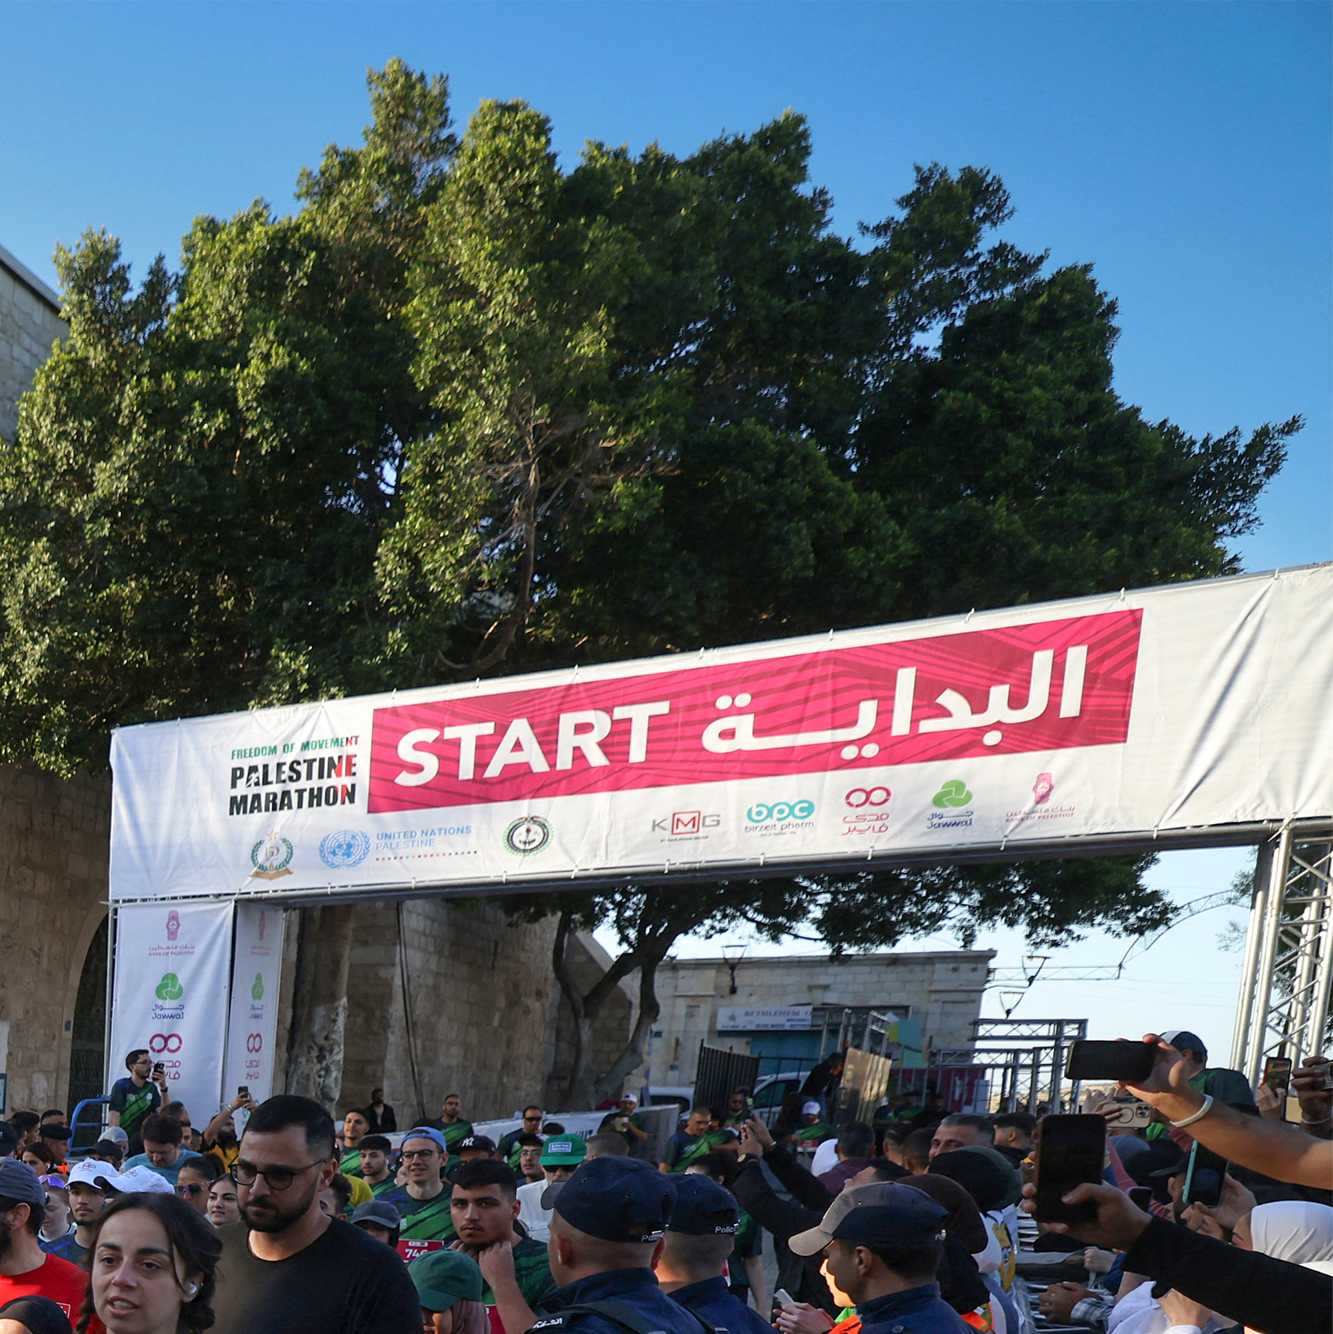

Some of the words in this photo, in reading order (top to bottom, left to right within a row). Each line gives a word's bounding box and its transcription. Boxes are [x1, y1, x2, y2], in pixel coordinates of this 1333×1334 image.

[701, 645, 1089, 760] البداية
[231, 745, 278, 760] FREEDOM
[283, 743, 295, 754] OF
[300, 735, 360, 752] MOVEMENT
[393, 700, 671, 787] START
[230, 754, 357, 789] PALESTINE
[229, 783, 356, 816] MARATHON
[376, 830, 418, 841] UNITED
[420, 825, 472, 838] NATIONS
[651, 811, 721, 834] KMG
[744, 822, 777, 834] birzeit
[926, 818, 973, 830] Jawwal
[375, 838, 435, 850] PALESTINE
[151, 1012, 184, 1020] Jawwal
